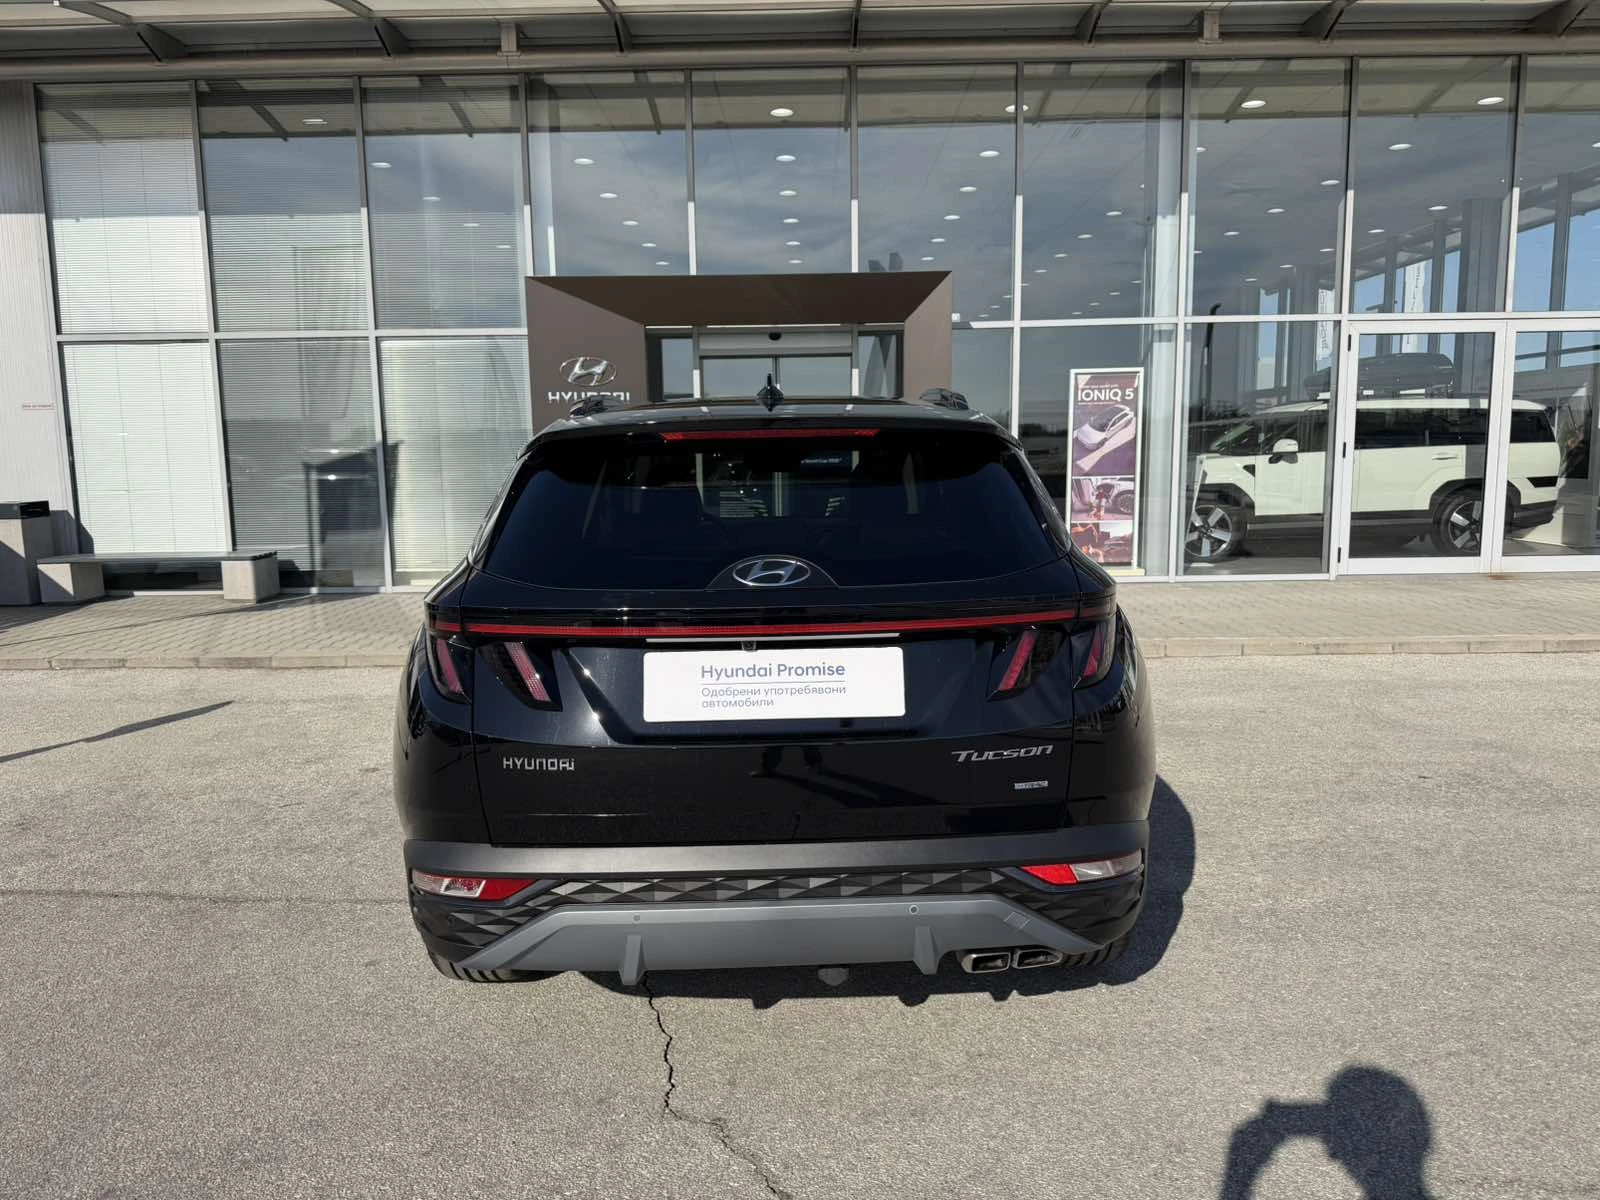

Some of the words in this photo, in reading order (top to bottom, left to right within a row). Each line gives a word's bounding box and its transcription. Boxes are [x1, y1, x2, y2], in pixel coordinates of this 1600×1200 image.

[548, 392, 630, 402] HYUI
[1078, 388, 1121, 402] IONIQ
[1125, 388, 1134, 400] 5
[701, 663, 773, 682] Hyundai
[777, 661, 846, 678] Promise
[701, 686, 761, 698] Одобрени
[764, 684, 847, 697] употребявани
[701, 697, 775, 708] автомобили
[502, 757, 575, 771] HYUNDAI
